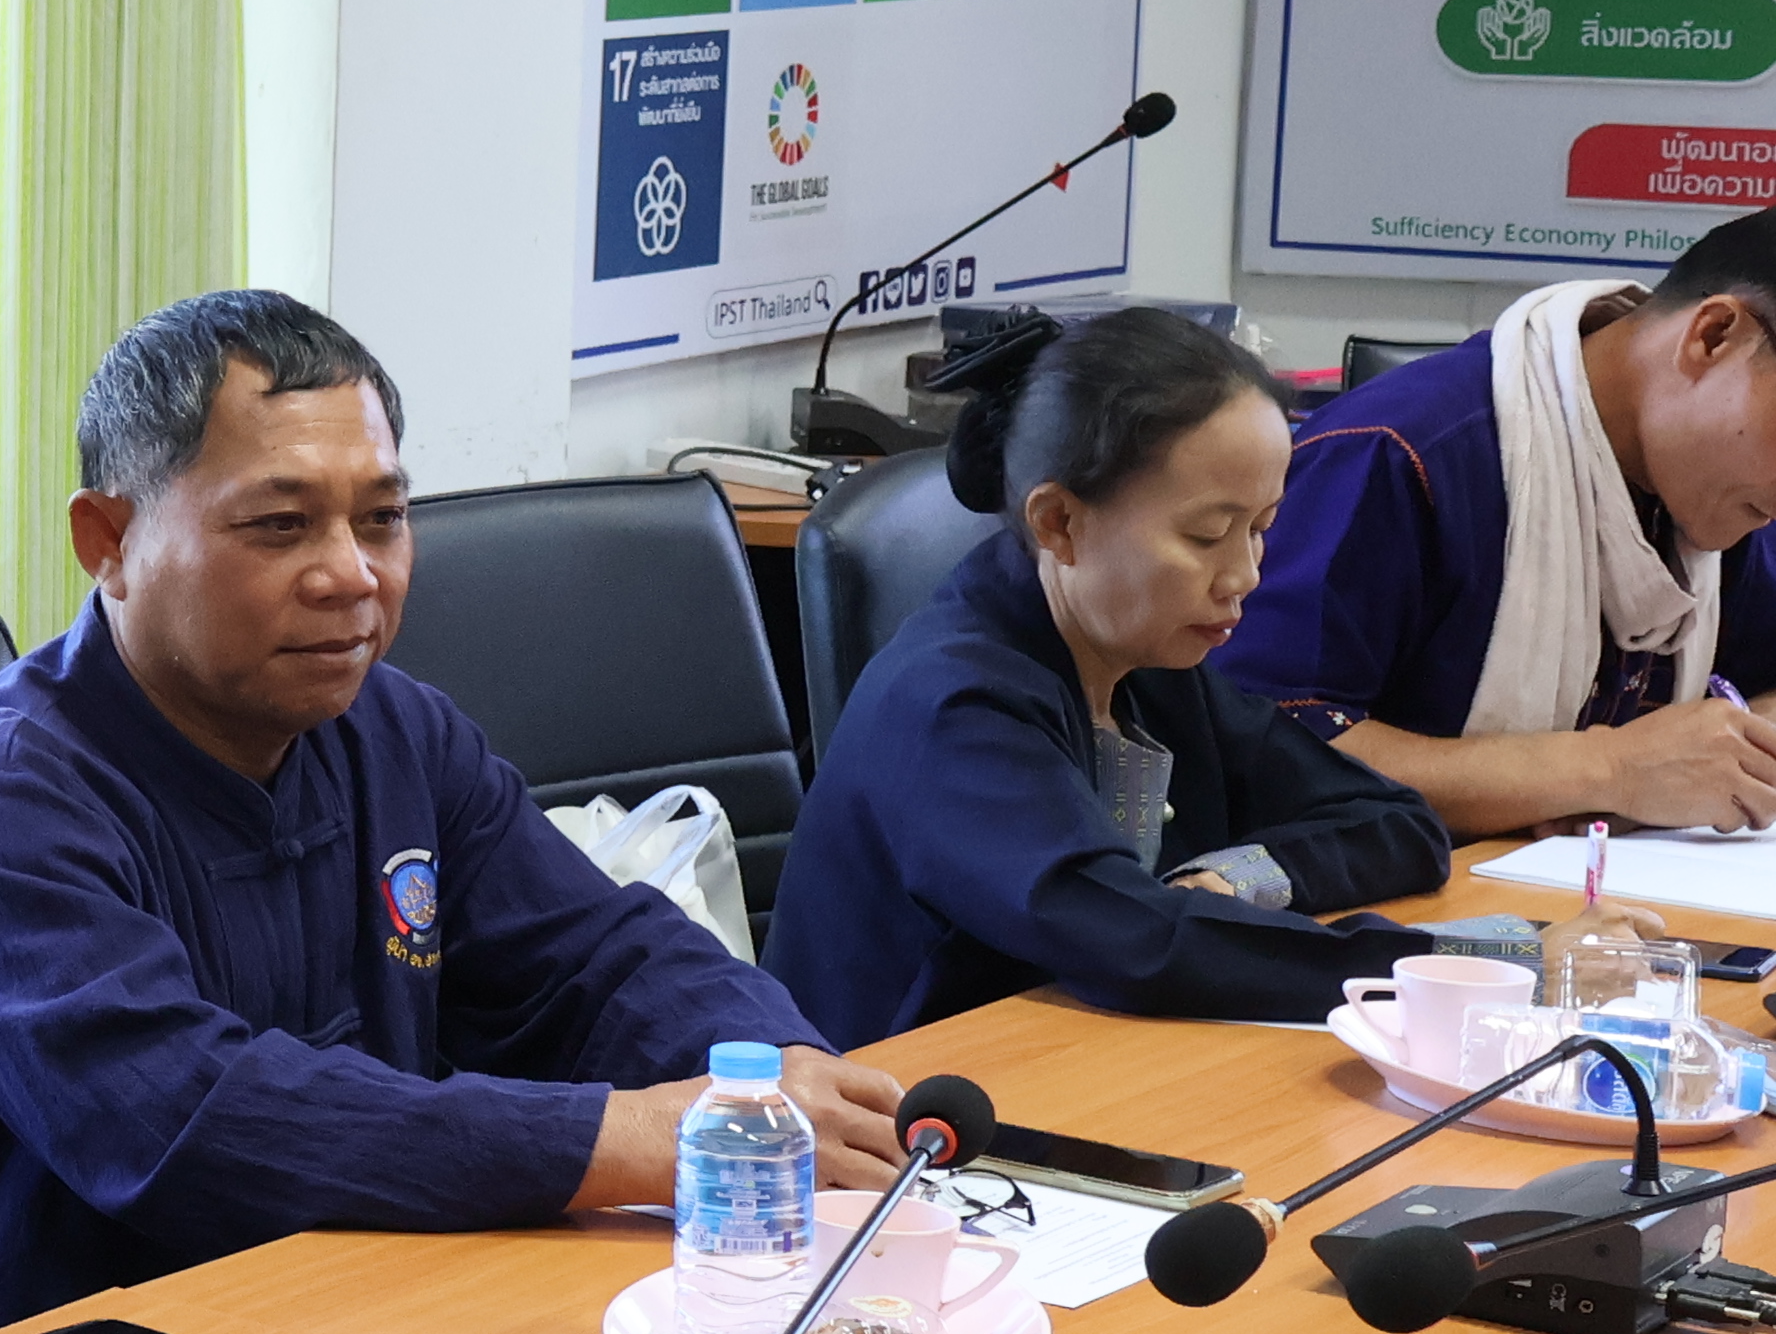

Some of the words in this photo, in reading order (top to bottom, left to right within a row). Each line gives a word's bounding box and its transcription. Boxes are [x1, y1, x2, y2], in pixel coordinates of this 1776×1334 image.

[1581, 12, 1733, 49] สิ่งแวดล้อม
[609, 50, 638, 102] 17
[750, 183, 766, 205] THE
[1371, 216, 1495, 247] Sufficiency
[1504, 223, 1617, 253] Economy
[1624, 228, 1697, 252] Philos
[714, 299, 747, 326] IPST
[751, 290, 811, 321] Thailand
